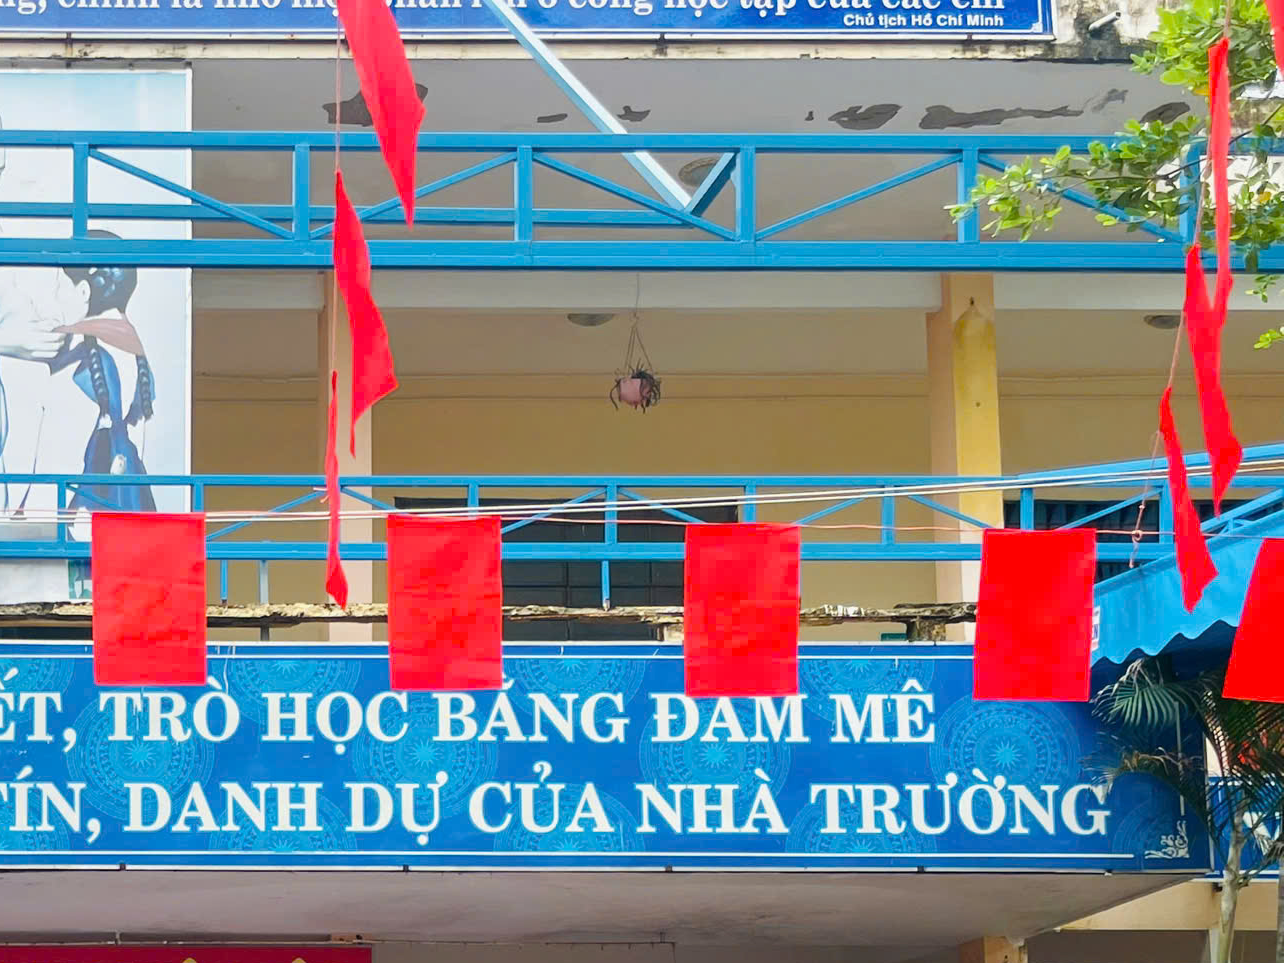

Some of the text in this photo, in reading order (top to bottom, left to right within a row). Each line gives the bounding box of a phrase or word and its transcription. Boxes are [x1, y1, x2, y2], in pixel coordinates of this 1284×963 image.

[843, 12, 1004, 29] Chủ tịch Hồ Chí Minh
[99, 680, 241, 743] TRÒ
[262, 692, 408, 755] HỌC
[831, 679, 936, 744] MÊ
[123, 781, 323, 833] DANH
[345, 769, 449, 845] DỰ
[468, 760, 614, 834] CỦA
[635, 768, 789, 836] NHÀ
[811, 773, 1112, 838] TRƯỜNG
